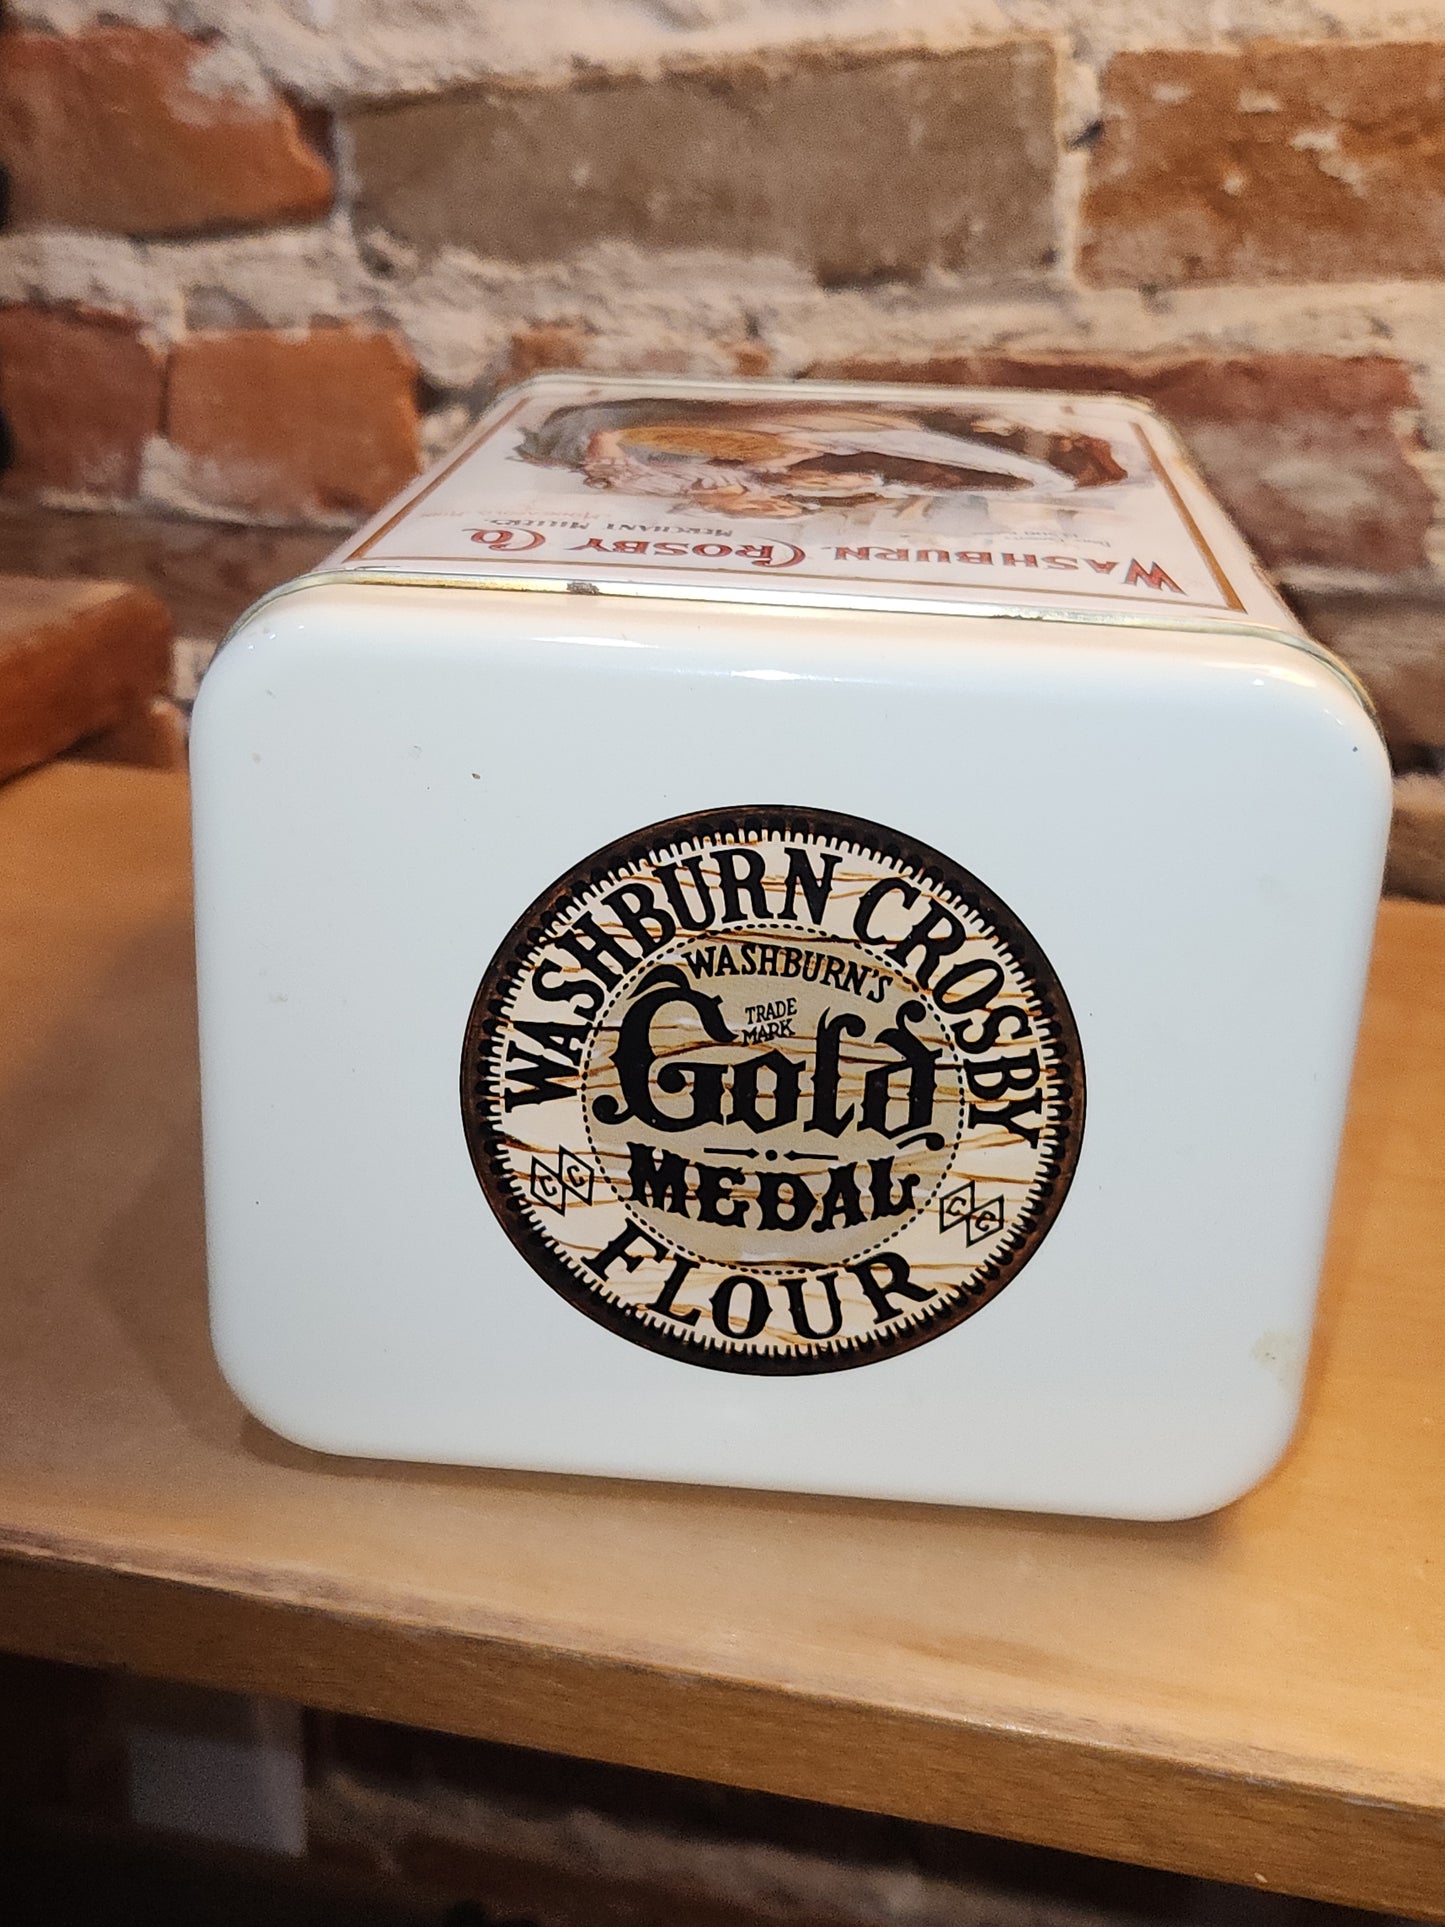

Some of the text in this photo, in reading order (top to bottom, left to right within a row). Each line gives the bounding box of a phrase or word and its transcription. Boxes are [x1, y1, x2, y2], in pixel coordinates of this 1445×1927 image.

[560, 536, 806, 568] CROSBY
[504, 847, 1042, 1149] WASHBURN CROSBY
[681, 944, 893, 1003] WASHBURN'S
[745, 997, 797, 1024] TRADE
[592, 965, 945, 1151] Gold
[742, 1018, 795, 1047] MARK
[626, 1141, 920, 1233] MEDAL
[580, 1218, 938, 1340] FLOUR
